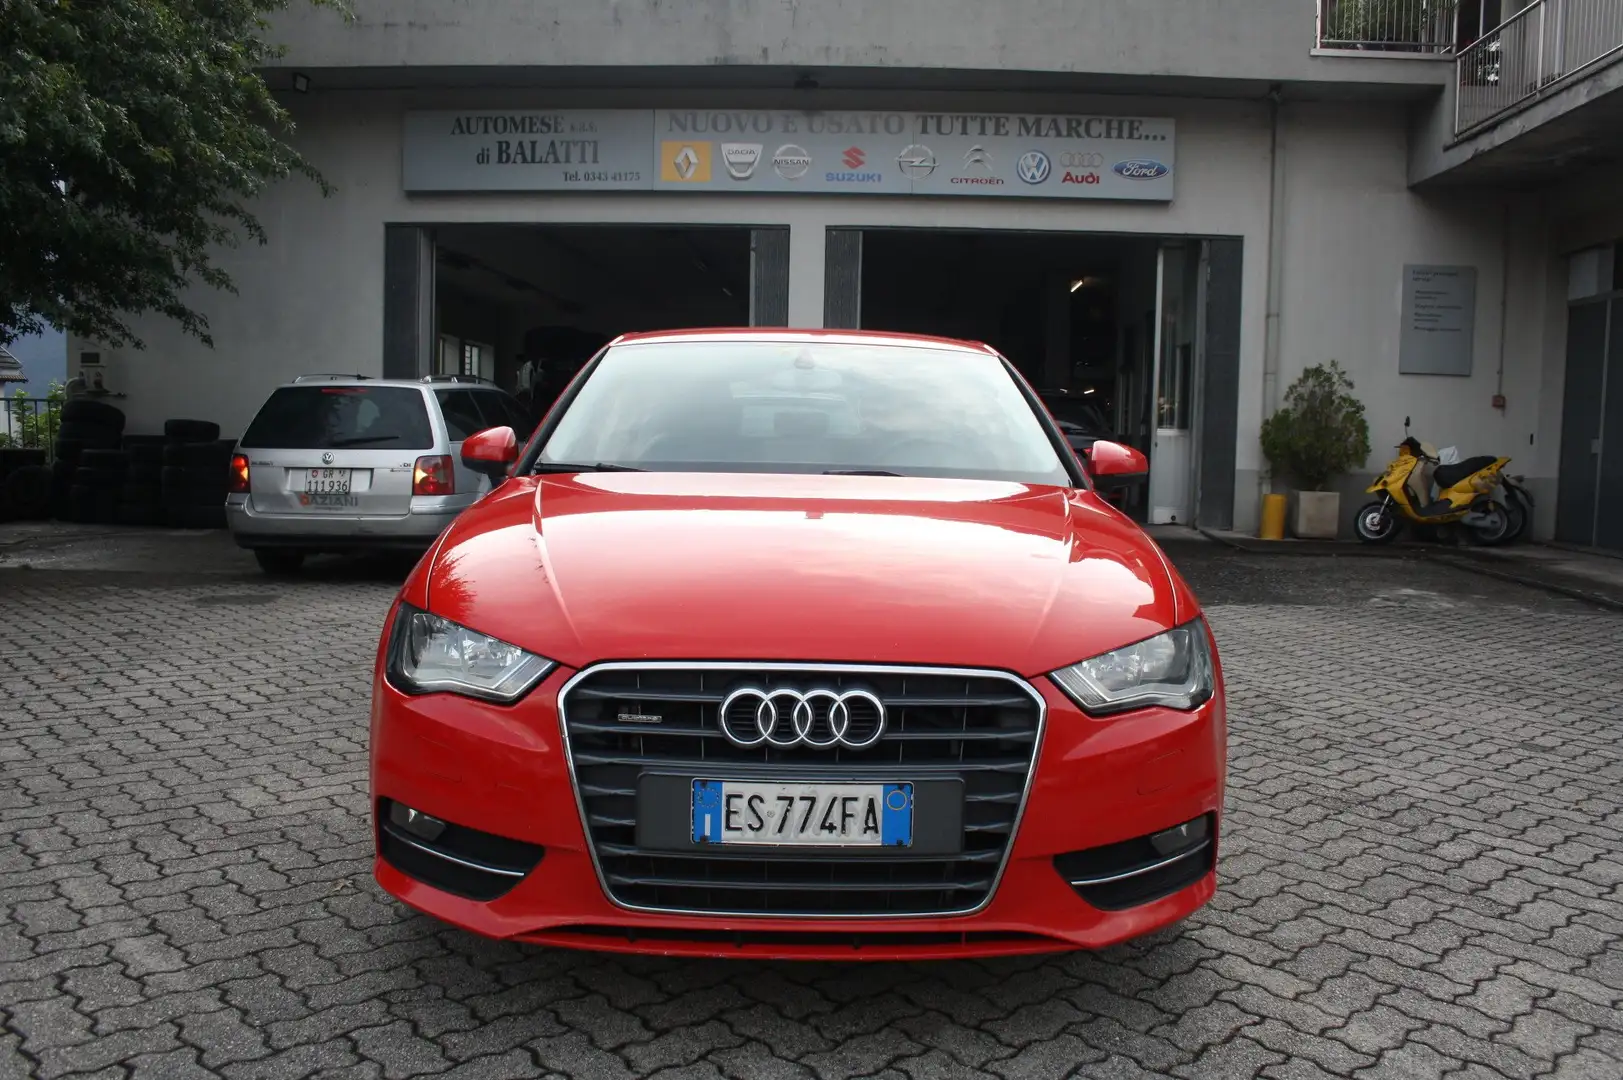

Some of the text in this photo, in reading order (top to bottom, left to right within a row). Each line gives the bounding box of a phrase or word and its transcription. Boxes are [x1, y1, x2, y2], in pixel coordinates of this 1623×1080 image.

[449, 115, 565, 135] AUTOMESE
[667, 112, 1166, 141] NUOVO E USATO TUTTE MARCHE...
[476, 140, 600, 165] di BALATTI
[727, 148, 756, 156] DACIA
[1122, 161, 1158, 177] Ford
[562, 171, 581, 182] Tel.
[584, 171, 608, 182] 0343
[825, 172, 882, 183] SUZUKI
[1062, 171, 1100, 185] Audi
[322, 469, 334, 479] GR
